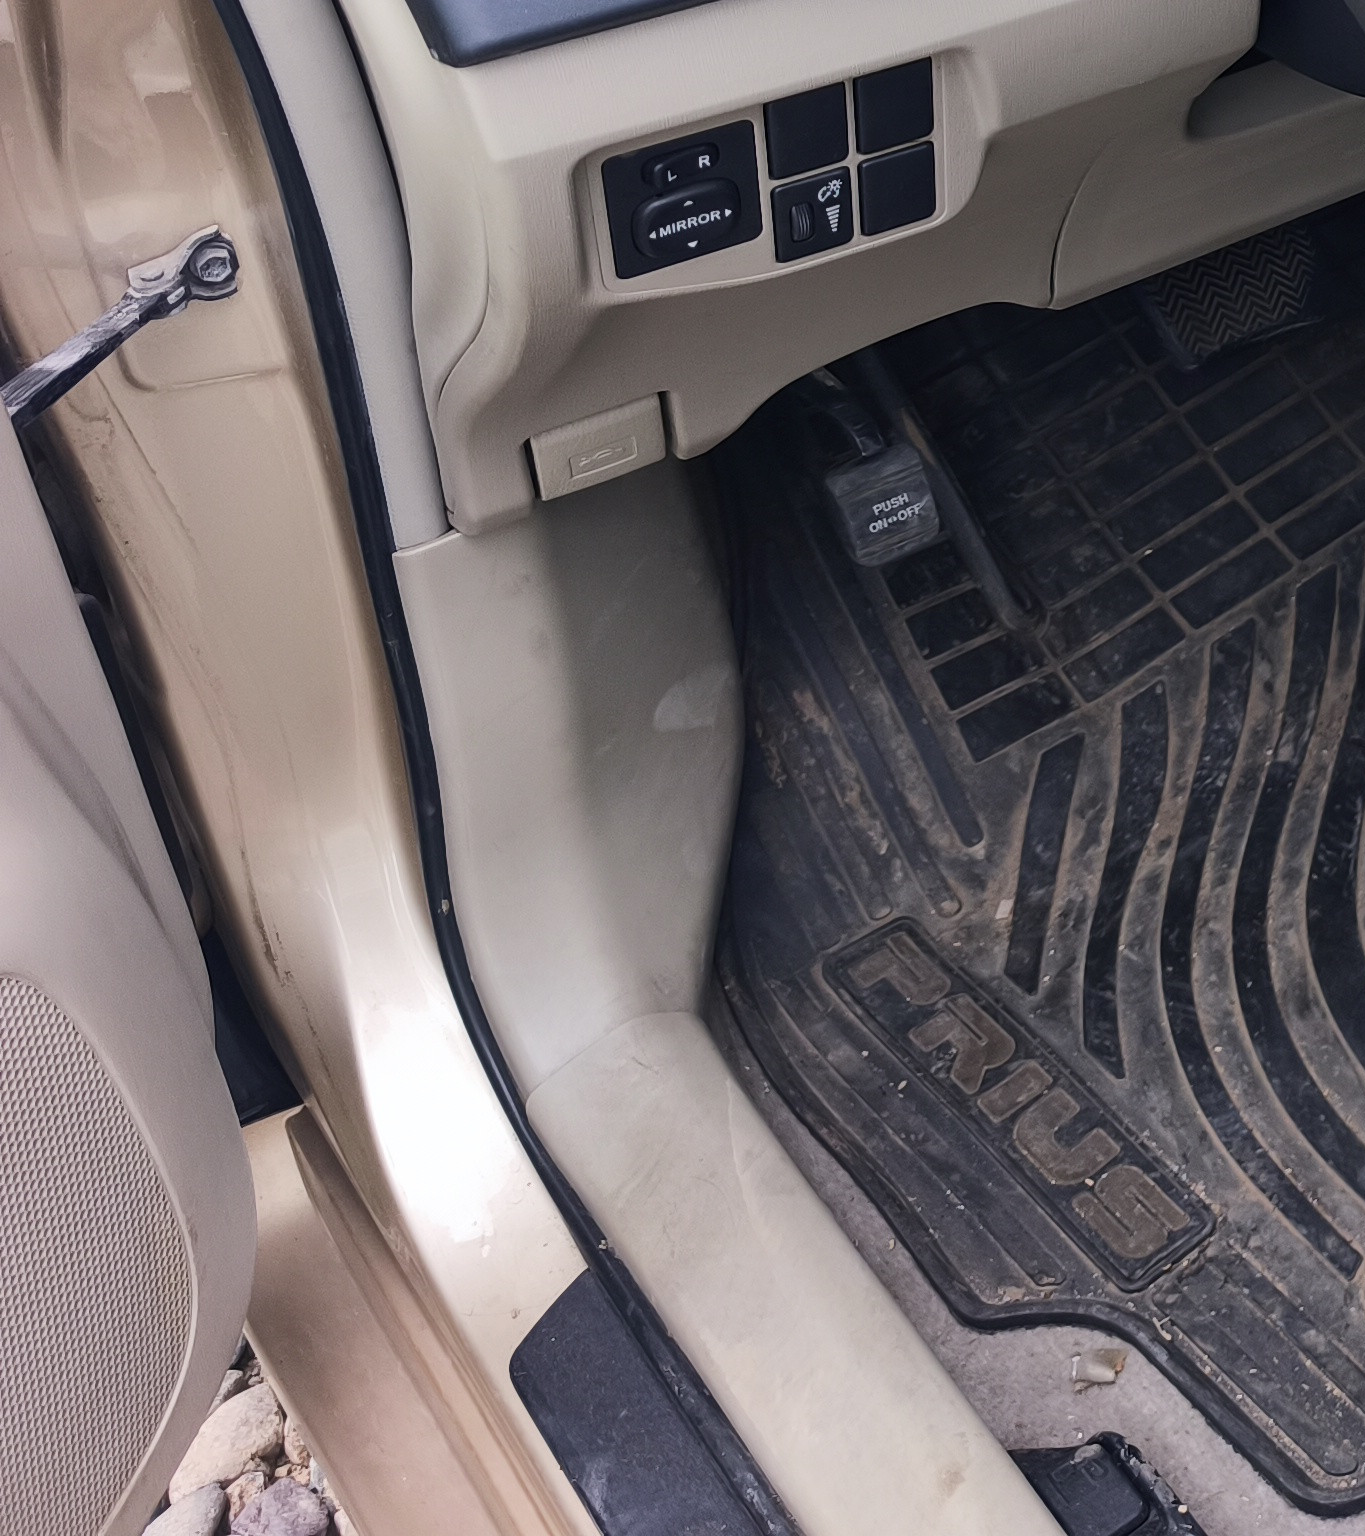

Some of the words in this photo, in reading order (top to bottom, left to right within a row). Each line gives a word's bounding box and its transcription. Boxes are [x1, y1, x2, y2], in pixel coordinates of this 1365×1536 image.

[667, 169, 678, 182] L
[698, 154, 711, 169] R
[659, 209, 721, 238] MIRROR
[872, 493, 910, 516] PUSH
[847, 931, 1191, 1259] PRIUS
